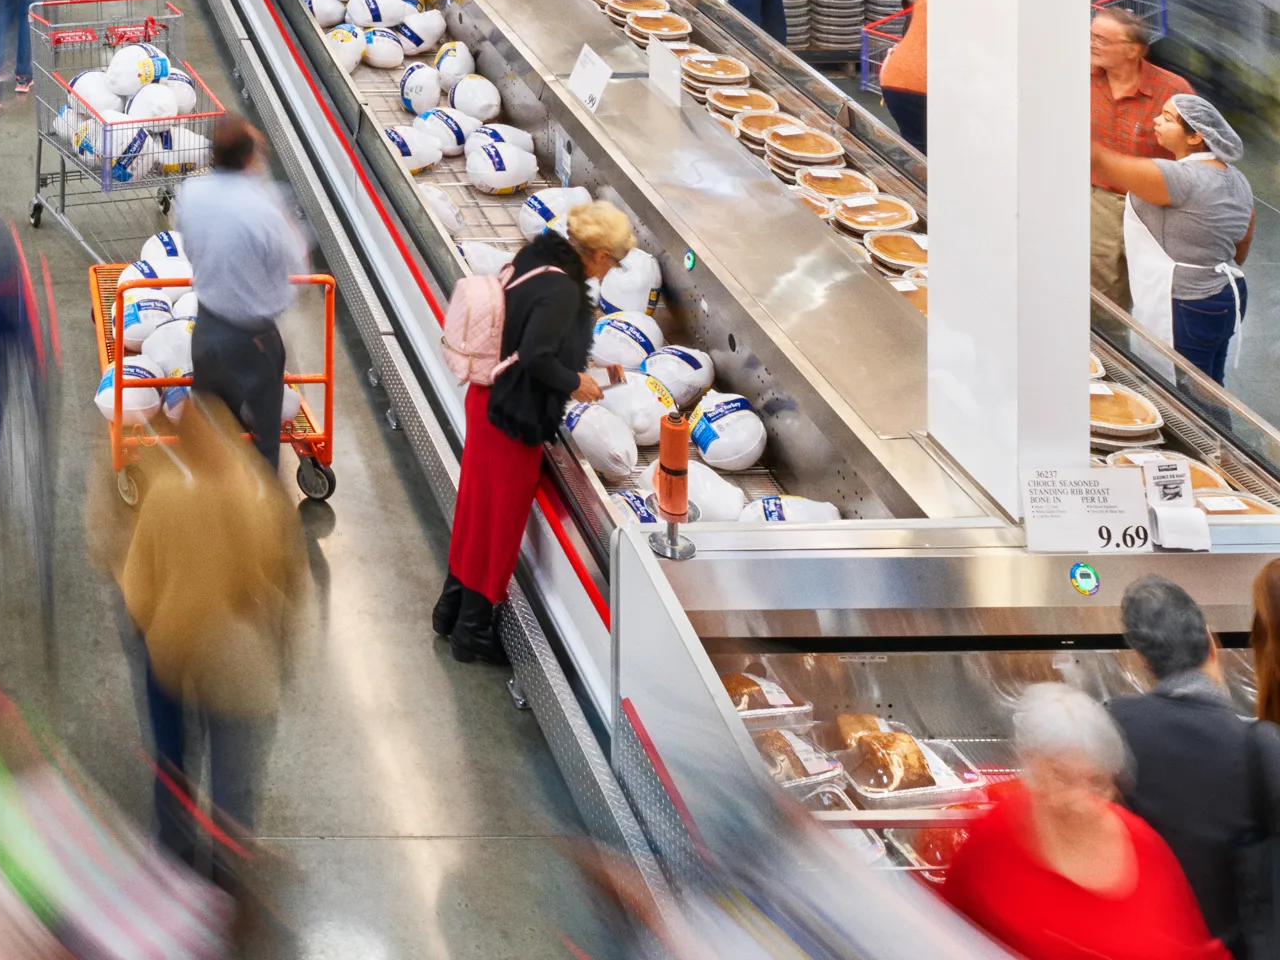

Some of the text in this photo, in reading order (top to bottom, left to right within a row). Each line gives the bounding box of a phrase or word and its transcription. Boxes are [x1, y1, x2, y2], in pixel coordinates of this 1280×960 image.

[723, 401, 741, 412] Turkey
[1036, 470, 1057, 479] 36237
[1030, 496, 1051, 504] BONE
[1098, 525, 1148, 548] 9.69
